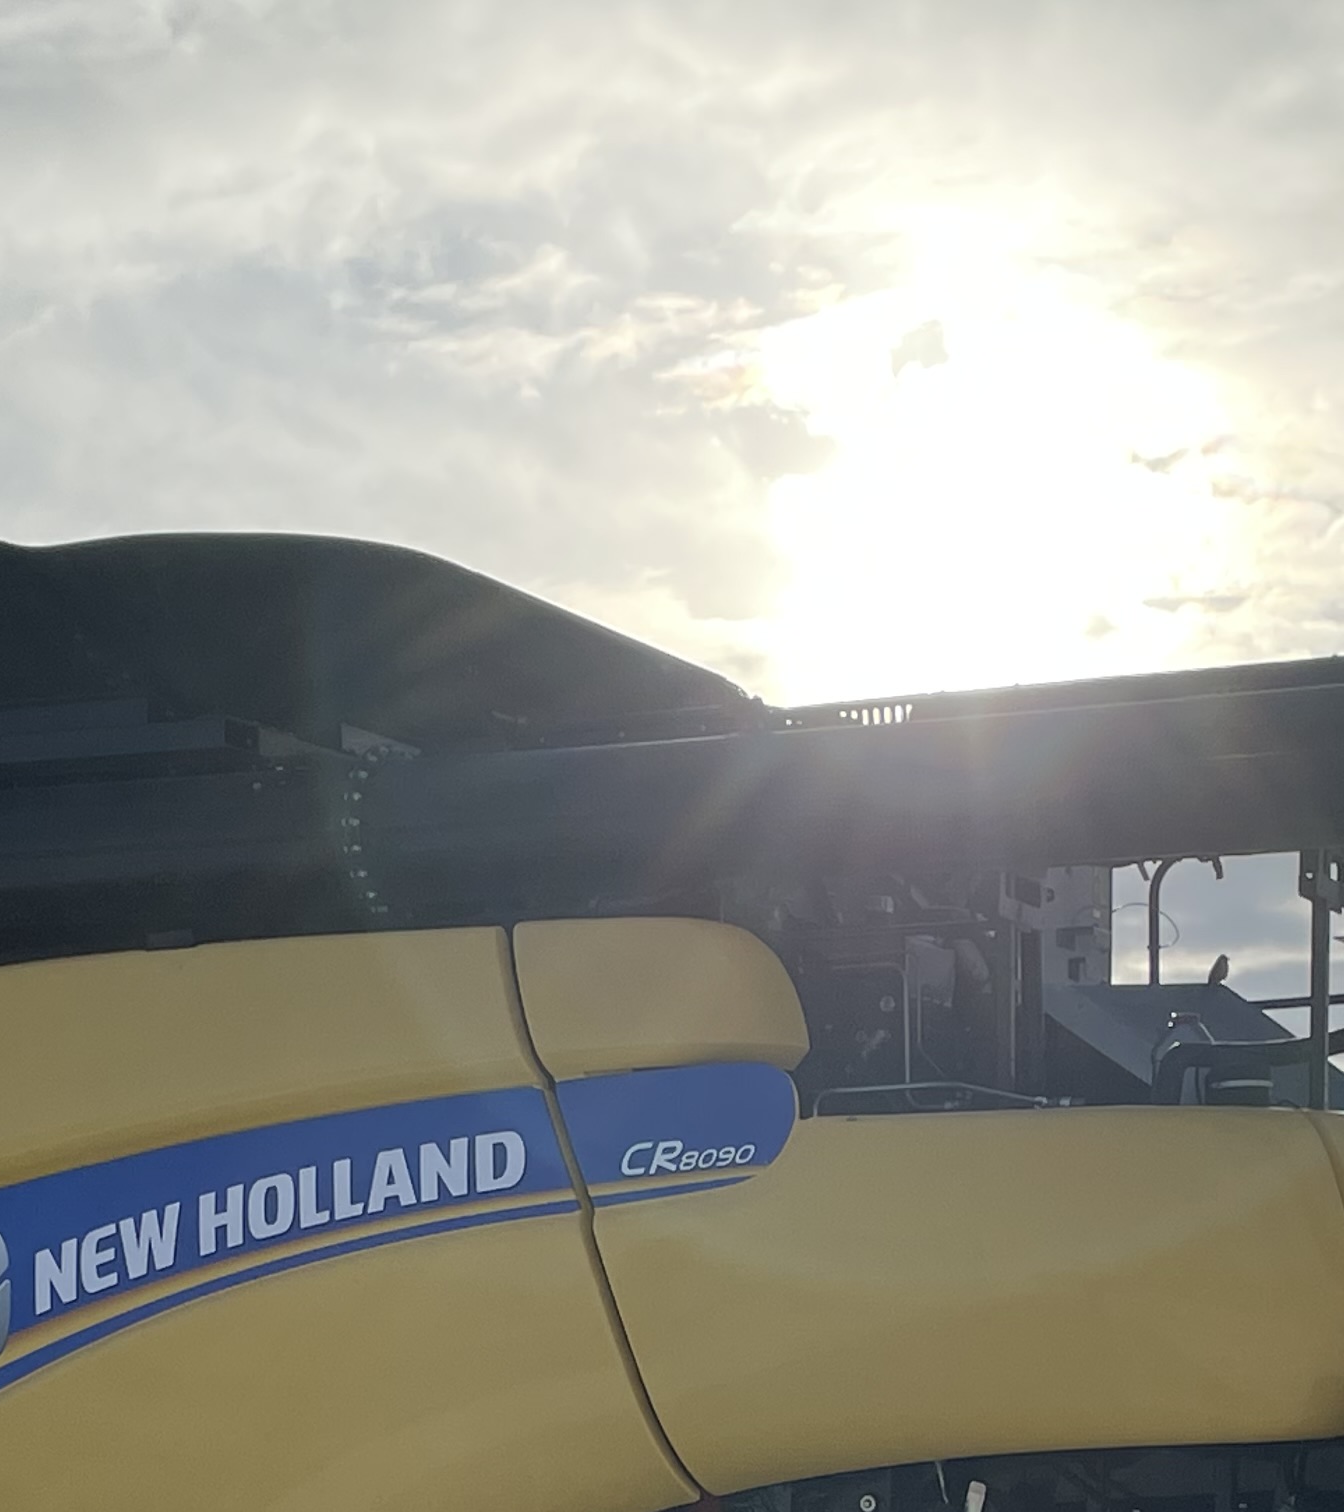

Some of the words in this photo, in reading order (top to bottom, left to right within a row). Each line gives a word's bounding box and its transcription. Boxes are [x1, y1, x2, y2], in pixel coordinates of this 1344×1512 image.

[621, 1140, 756, 1176] CR8090
[34, 1201, 181, 1316] NEW
[199, 1130, 526, 1257] HOLLAND
